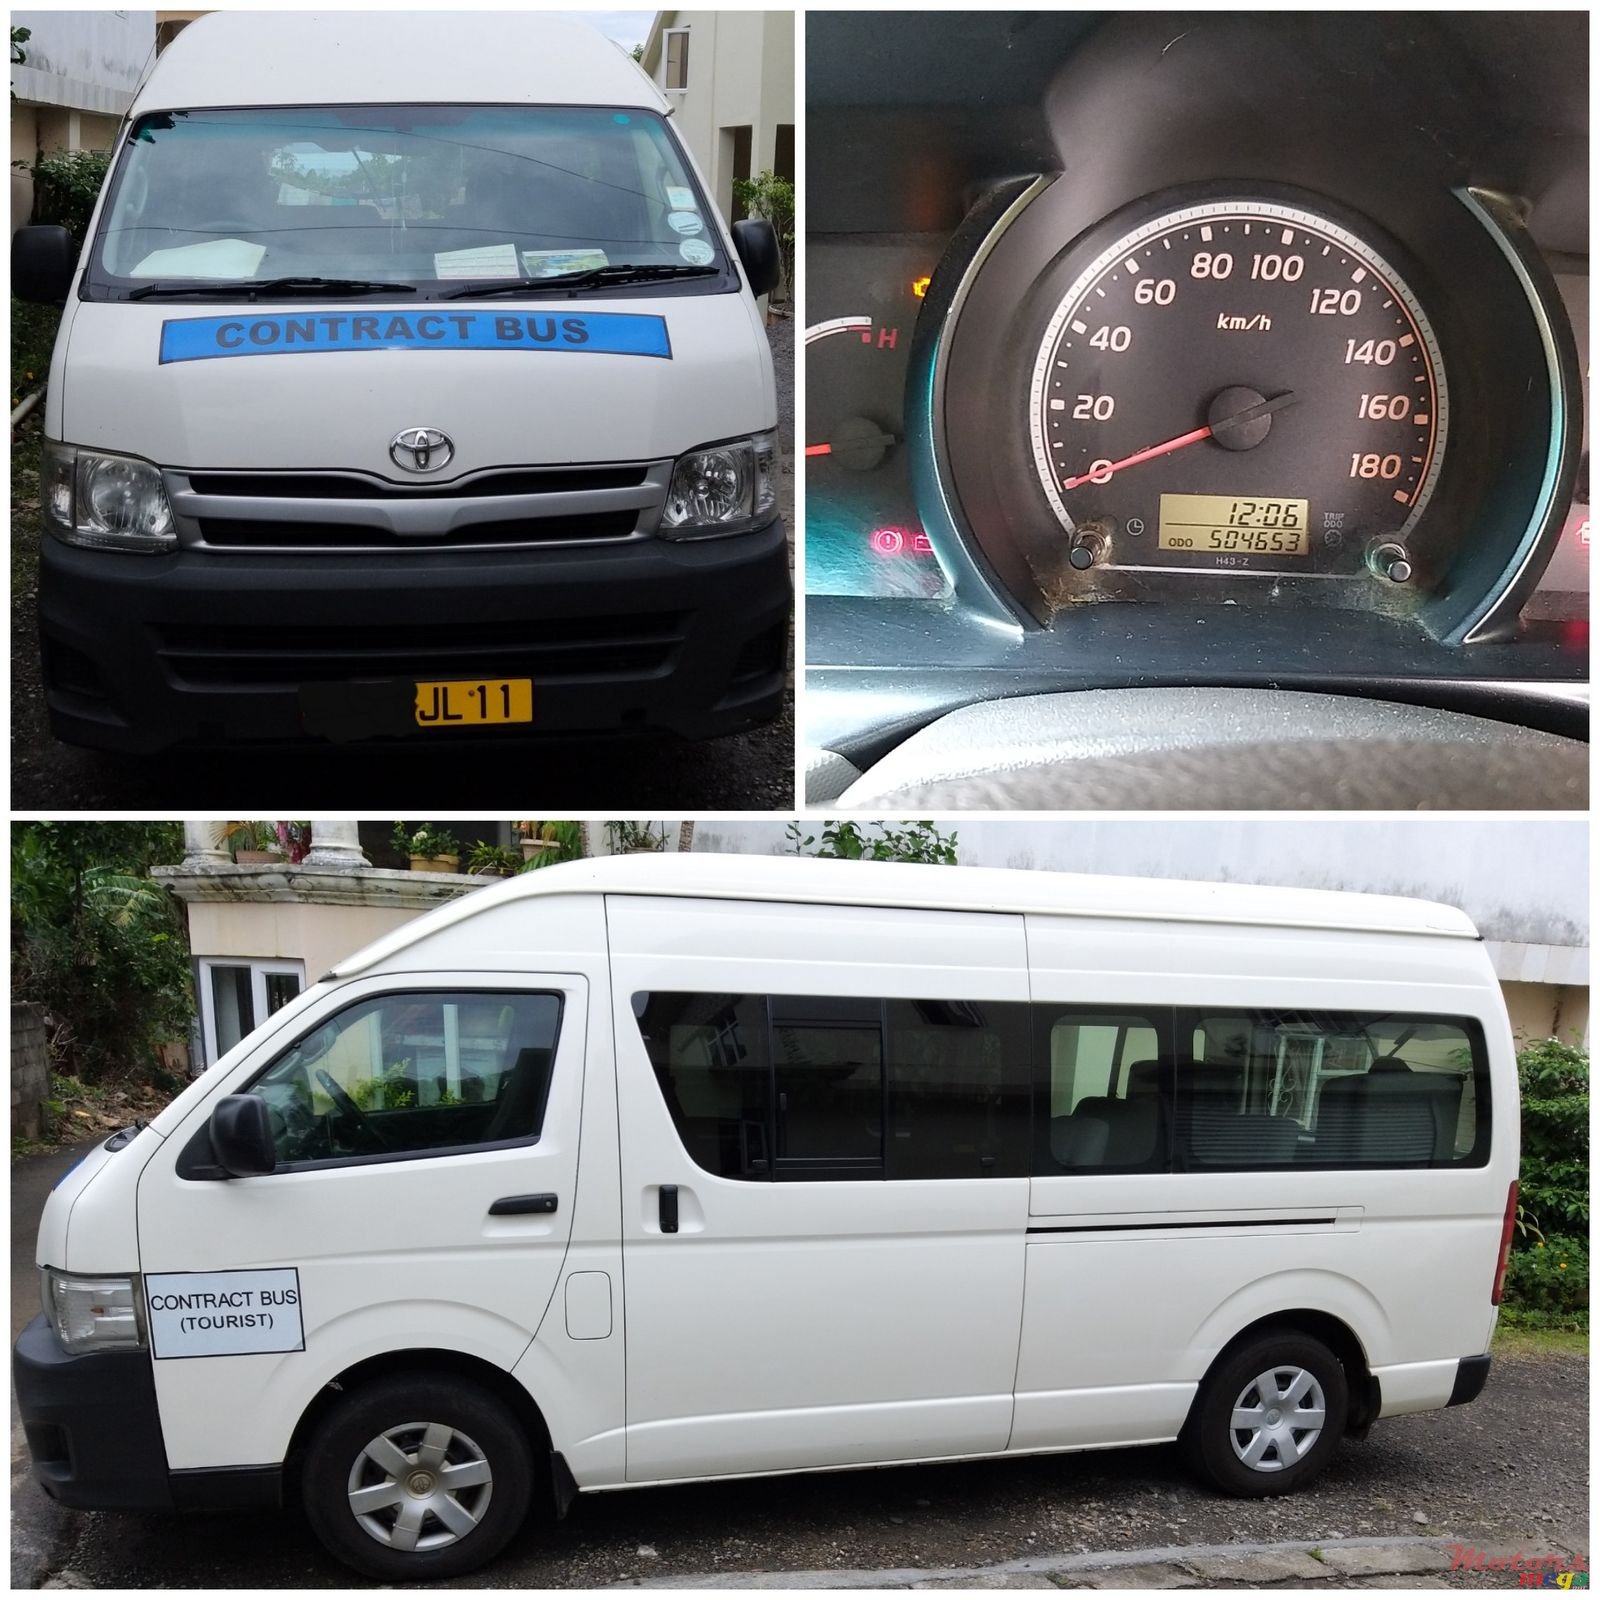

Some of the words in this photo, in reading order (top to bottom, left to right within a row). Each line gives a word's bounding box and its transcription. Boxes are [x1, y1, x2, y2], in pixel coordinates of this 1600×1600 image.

[1190, 253, 1233, 279] 80
[1251, 255, 1304, 282] 100
[1134, 279, 1176, 306] 60
[1310, 289, 1362, 316] 120
[215, 315, 476, 345] CONTRACT
[495, 316, 590, 344] BUS
[1216, 312, 1272, 331] km/h
[877, 328, 898, 349] H
[1089, 326, 1131, 352] 40
[1344, 339, 1396, 366] 140
[1072, 395, 1115, 421] 20
[1358, 394, 1410, 420] 160
[1089, 459, 1114, 484] 0
[1350, 453, 1401, 479] 180
[1228, 502, 1299, 528] 12:06
[1323, 512, 1345, 520] TRIP
[1323, 520, 1343, 528] ODO
[1168, 537, 1194, 548] ODO
[1208, 529, 1301, 552] 504653
[1215, 557, 1249, 566] H43-Z
[419, 686, 464, 721] JL
[477, 684, 510, 719] 11
[150, 1292, 254, 1311] CONTRACT
[260, 1289, 298, 1306] BUS
[180, 1313, 274, 1334] (TOURIST)
